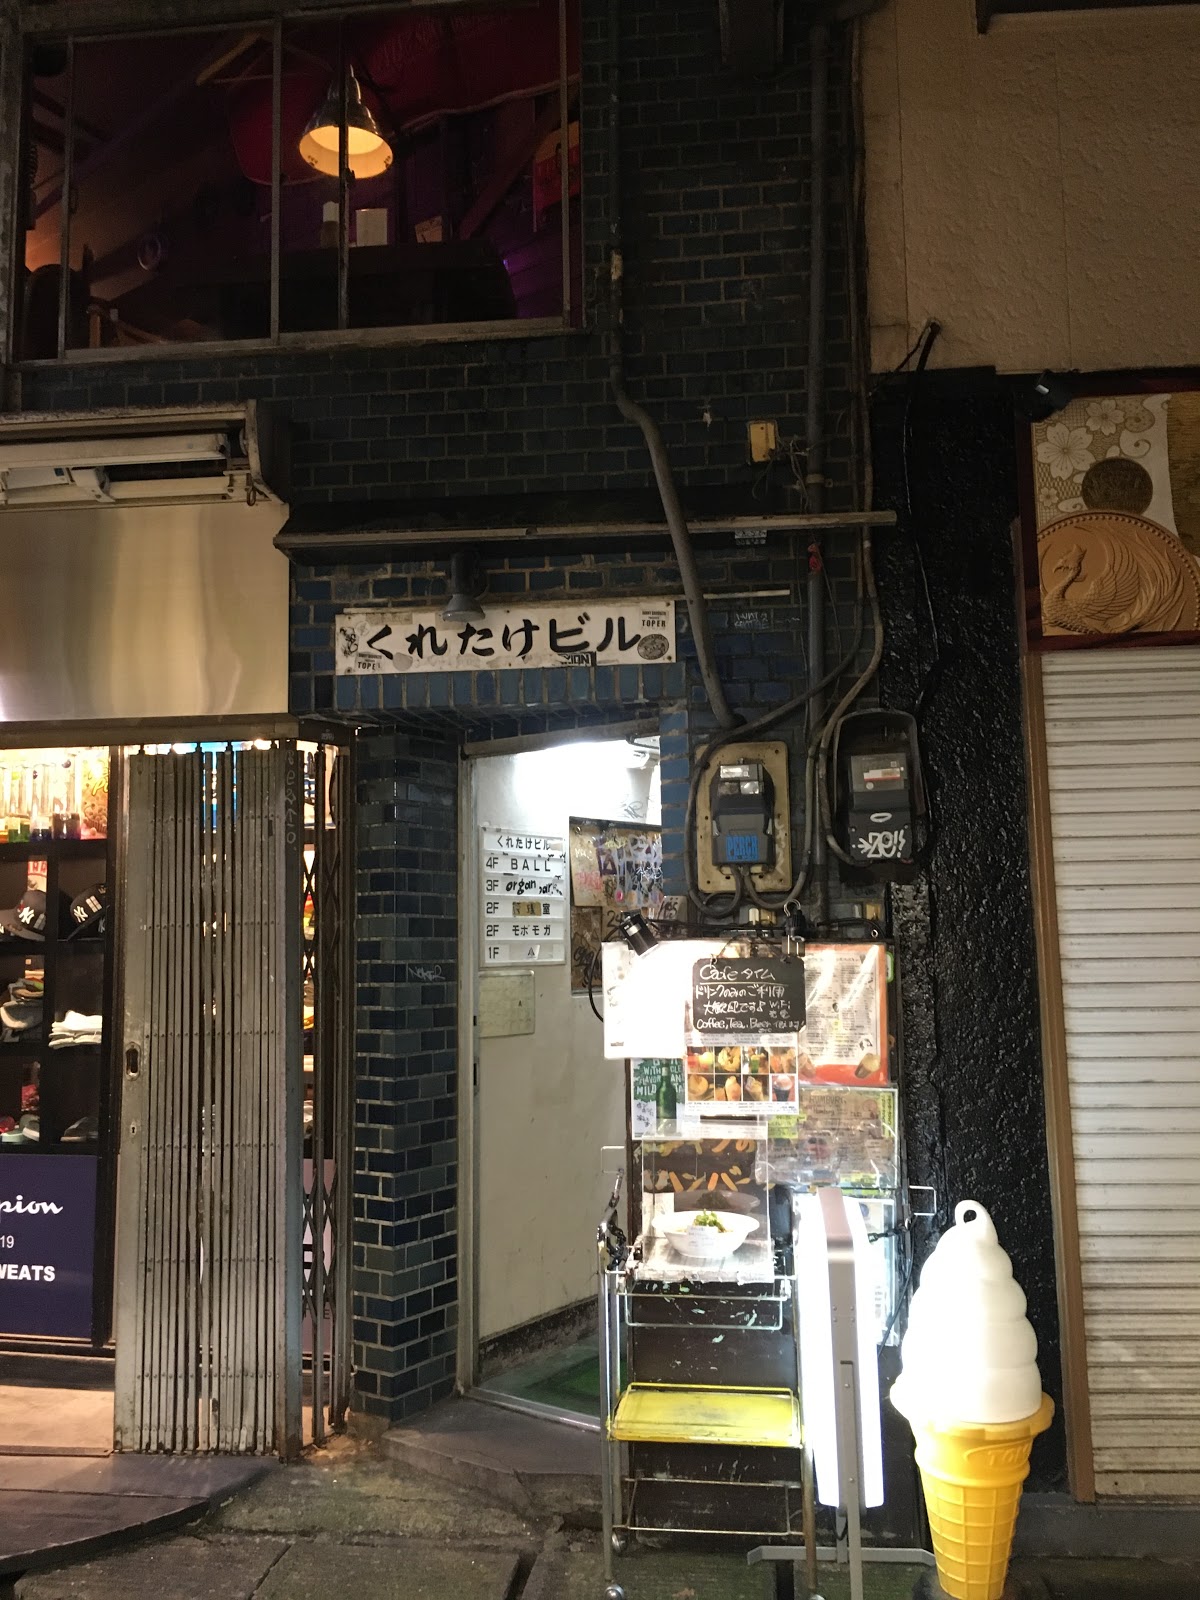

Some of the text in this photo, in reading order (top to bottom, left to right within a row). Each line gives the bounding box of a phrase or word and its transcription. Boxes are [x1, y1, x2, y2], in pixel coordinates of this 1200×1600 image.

[642, 619, 666, 628] TOPER
[366, 613, 642, 659] くれたけビル
[497, 835, 551, 851] くれたけビル
[486, 857, 551, 872] 4F BALL
[486, 879, 499, 891] 3F
[506, 878, 537, 895] organ
[486, 902, 499, 914] 2F
[486, 925, 499, 936] 2F
[488, 947, 500, 959] 1F
[700, 964, 776, 980] Cafe タイム
[695, 984, 785, 999] ドリンクのみのご利用
[636, 1084, 657, 1096] MILD
